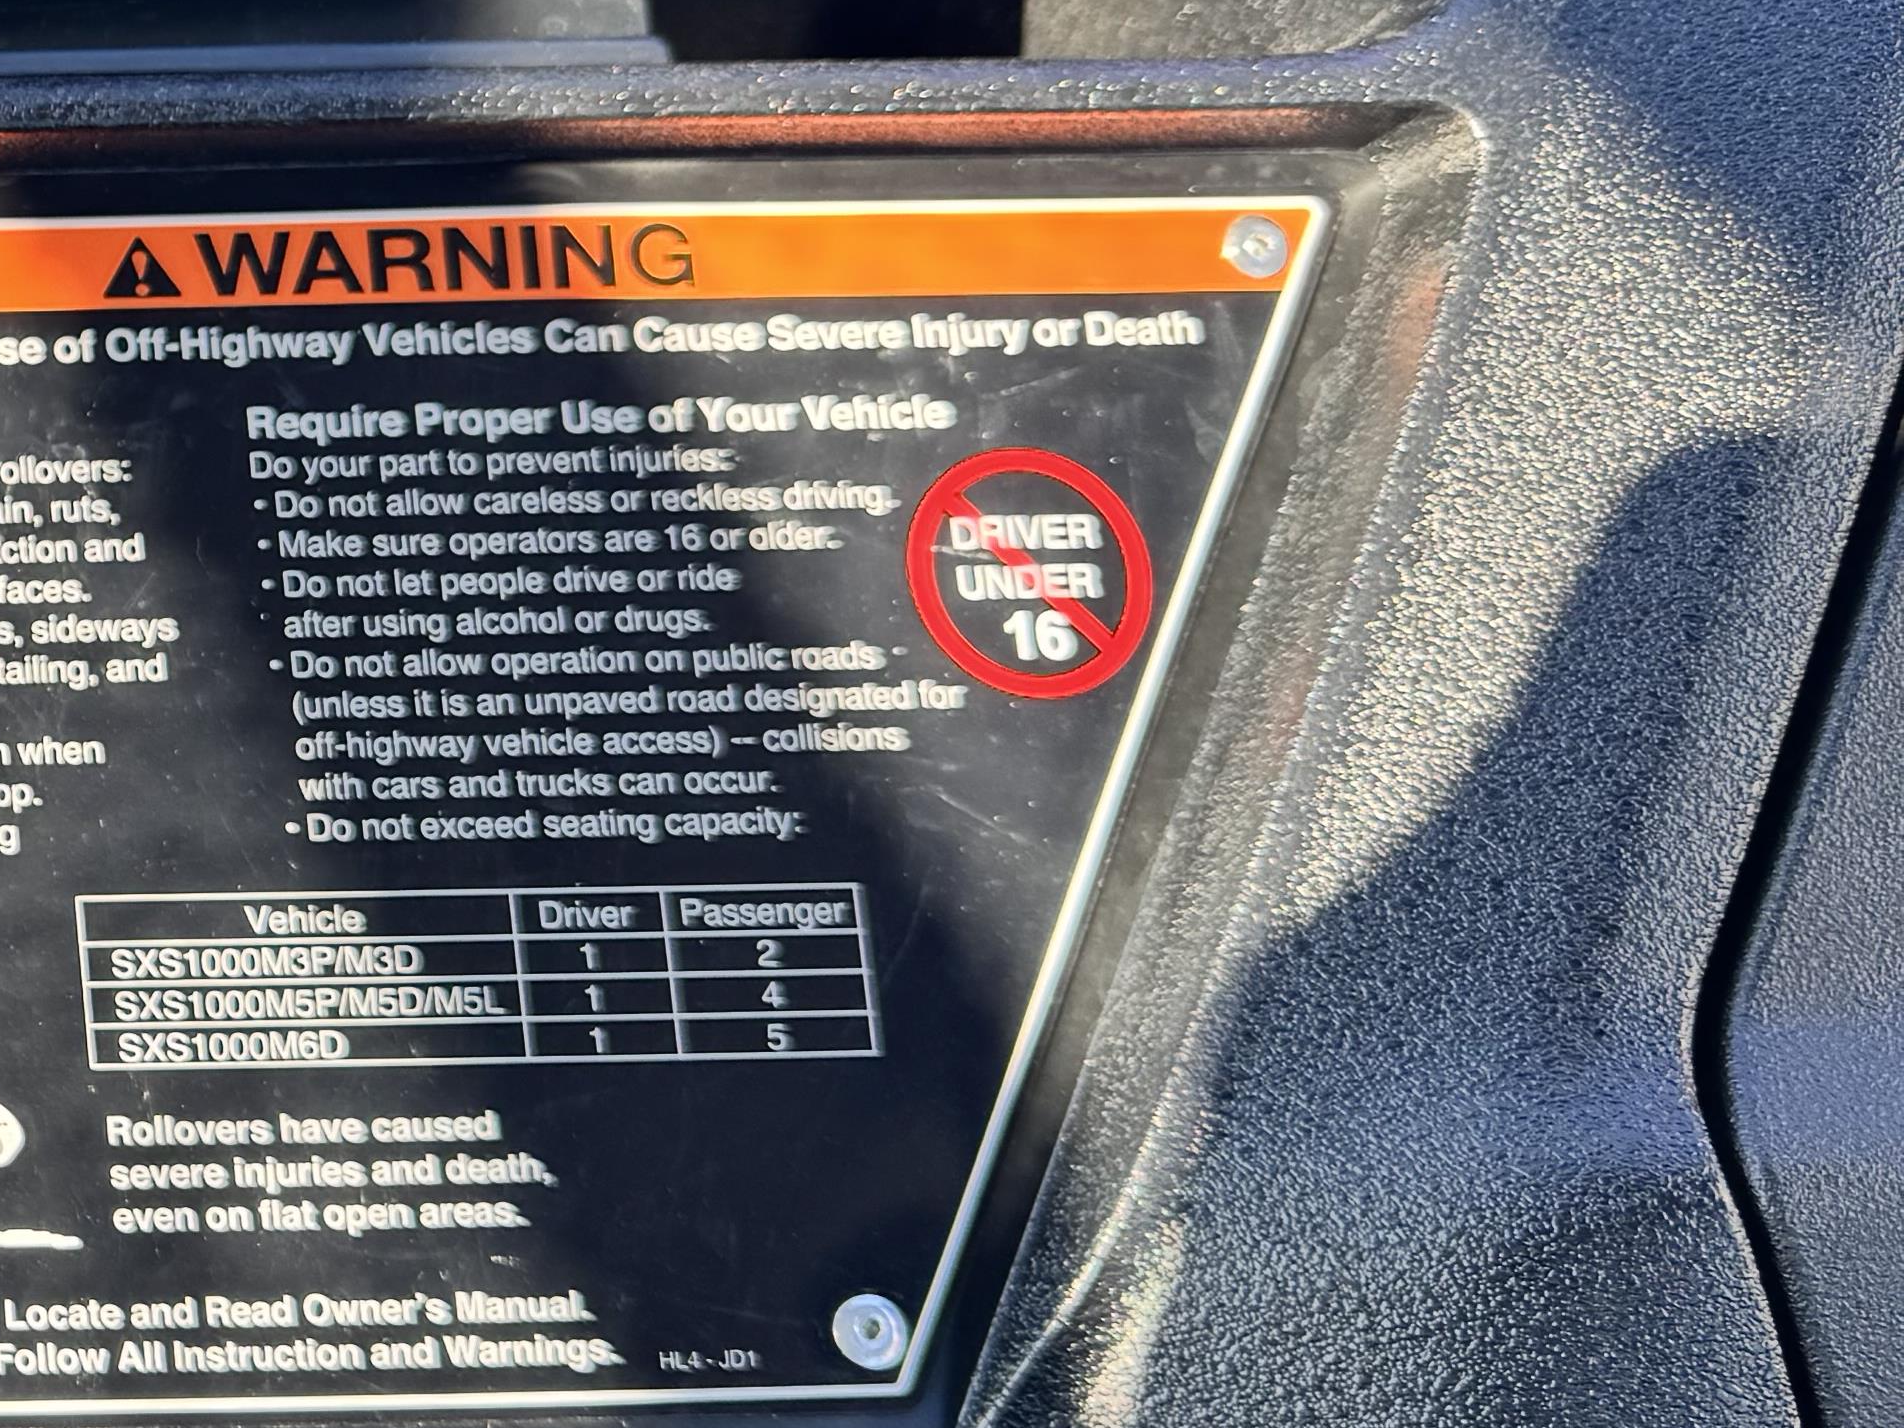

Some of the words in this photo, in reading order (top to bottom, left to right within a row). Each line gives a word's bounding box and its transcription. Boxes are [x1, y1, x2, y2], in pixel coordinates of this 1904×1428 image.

[194, 223, 695, 296] WARNING
[53, 328, 96, 363] of
[105, 325, 353, 368] Off-Highway
[362, 321, 536, 356] Vehicles
[544, 318, 627, 353] Can
[633, 316, 766, 353] Cause
[766, 313, 905, 352] Severe
[911, 313, 1030, 356] Injury
[1032, 317, 1082, 348] or
[1083, 309, 1204, 346] Death
[246, 403, 407, 445] Require
[414, 401, 553, 443] Proper
[560, 399, 642, 434] Use
[648, 396, 693, 433] of
[695, 398, 793, 434] Your
[801, 394, 956, 432] Vehicle
[50, 494, 121, 525] ruts,
[949, 514, 1104, 550] DRIVER
[282, 569, 328, 598] Do
[336, 569, 388, 597] not
[393, 568, 434, 597] let
[440, 565, 547, 601] people
[552, 564, 631, 594] drive
[636, 569, 672, 592] or
[677, 562, 739, 591] ride
[955, 563, 1104, 601] UNDER
[30, 612, 180, 648] sideways
[283, 608, 354, 639] after
[362, 608, 447, 643] using
[456, 605, 566, 635] alcohol
[574, 610, 606, 633] or
[614, 604, 710, 639] drugs.
[1003, 609, 1079, 661] 16
[16, 735, 106, 765] when
[306, 811, 356, 842] Do
[361, 812, 415, 841] not
[420, 808, 537, 840] exceed
[542, 807, 660, 844] seating
[664, 805, 803, 841] capacity:
[243, 904, 367, 935] Vehicle
[538, 899, 635, 929] Driver
[679, 897, 849, 930] Passenger
[110, 944, 424, 980] SXS1000M3P/M3D
[579, 942, 601, 970] 1
[756, 938, 784, 968] 2
[113, 985, 509, 1022] SXS1000M5P/M5D/M5L
[584, 983, 606, 1012] 1
[761, 980, 790, 1009] 4
[117, 1029, 349, 1063] SXS1000M6D
[589, 1026, 610, 1054] 1
[766, 1023, 792, 1051] 5
[106, 1114, 274, 1146] Rollovers
[279, 1112, 368, 1144] have
[371, 1109, 500, 1142] caused
[109, 1162, 229, 1190] severe
[233, 1154, 368, 1193] injuries
[371, 1153, 442, 1186] and
[445, 1151, 554, 1185] death,
[4, 1298, 126, 1331] Locate
[130, 1295, 199, 1330] and
[204, 1293, 299, 1329] Read
[302, 1291, 453, 1327] Owner's
[454, 1288, 597, 1324] Manual.
[117, 1339, 168, 1374] All
[172, 1337, 366, 1373] Instruction
[370, 1334, 441, 1370] and
[442, 1332, 625, 1373] Warnings.
